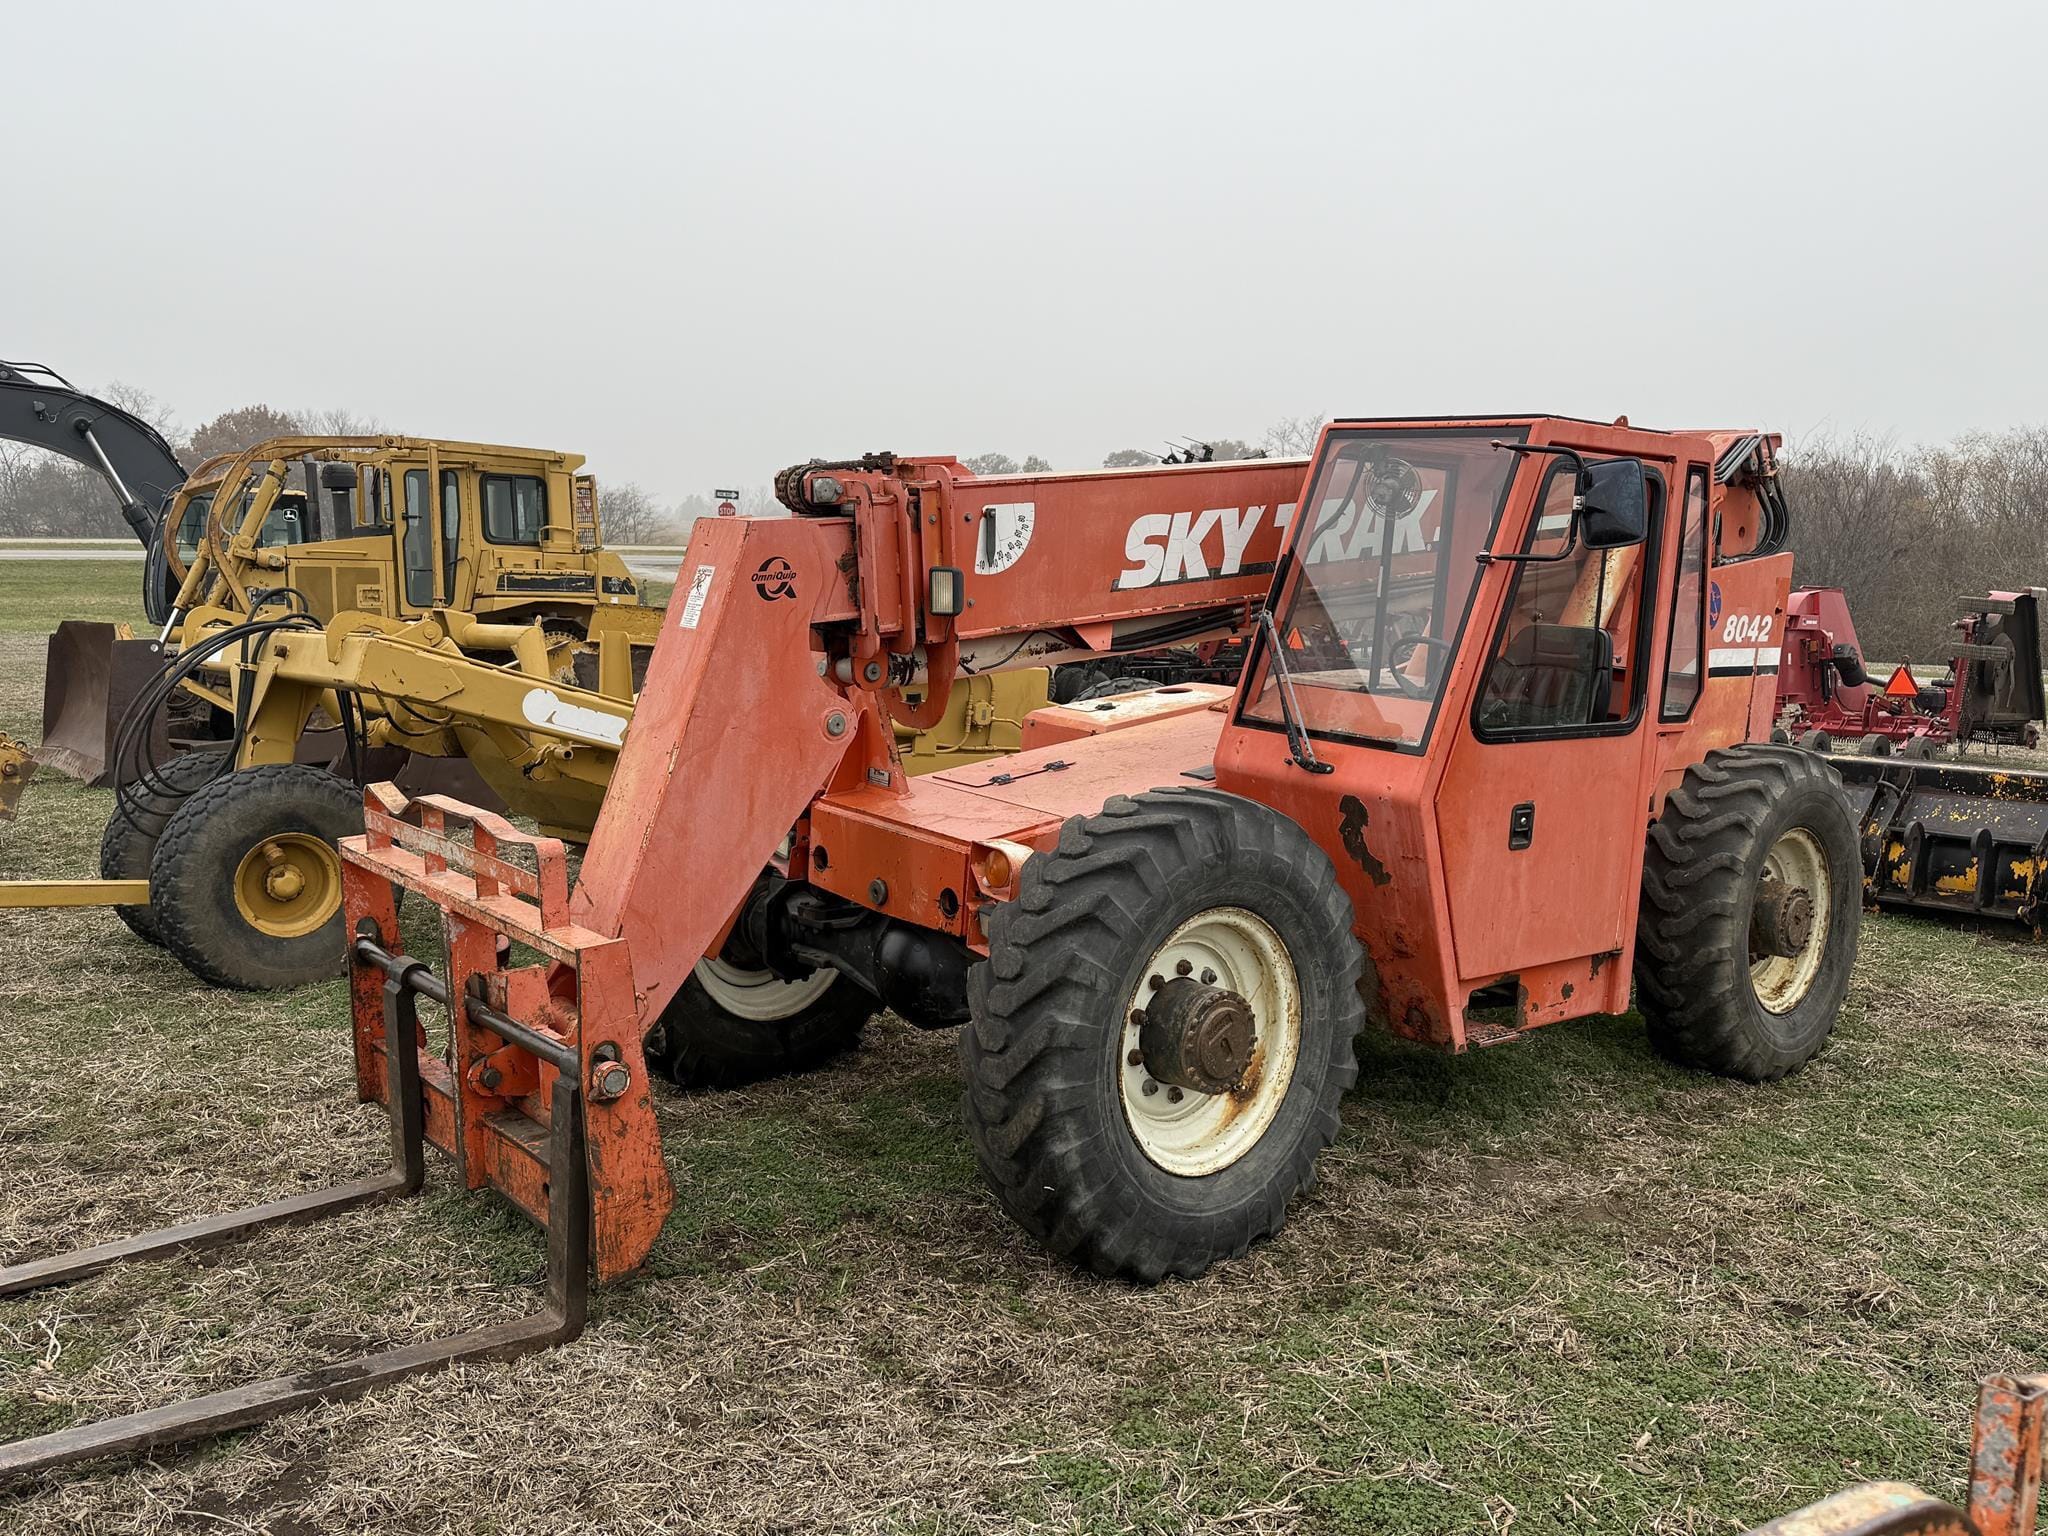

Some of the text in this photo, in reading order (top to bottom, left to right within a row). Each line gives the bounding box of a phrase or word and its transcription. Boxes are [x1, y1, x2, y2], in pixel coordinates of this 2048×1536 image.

[719, 507, 735, 515] STOP
[1021, 523, 1029, 532] 70
[1014, 529, 1023, 538] 60
[1118, 505, 1267, 588] SKY
[751, 571, 797, 582] OmniQuip
[1723, 614, 1773, 643] 8042
